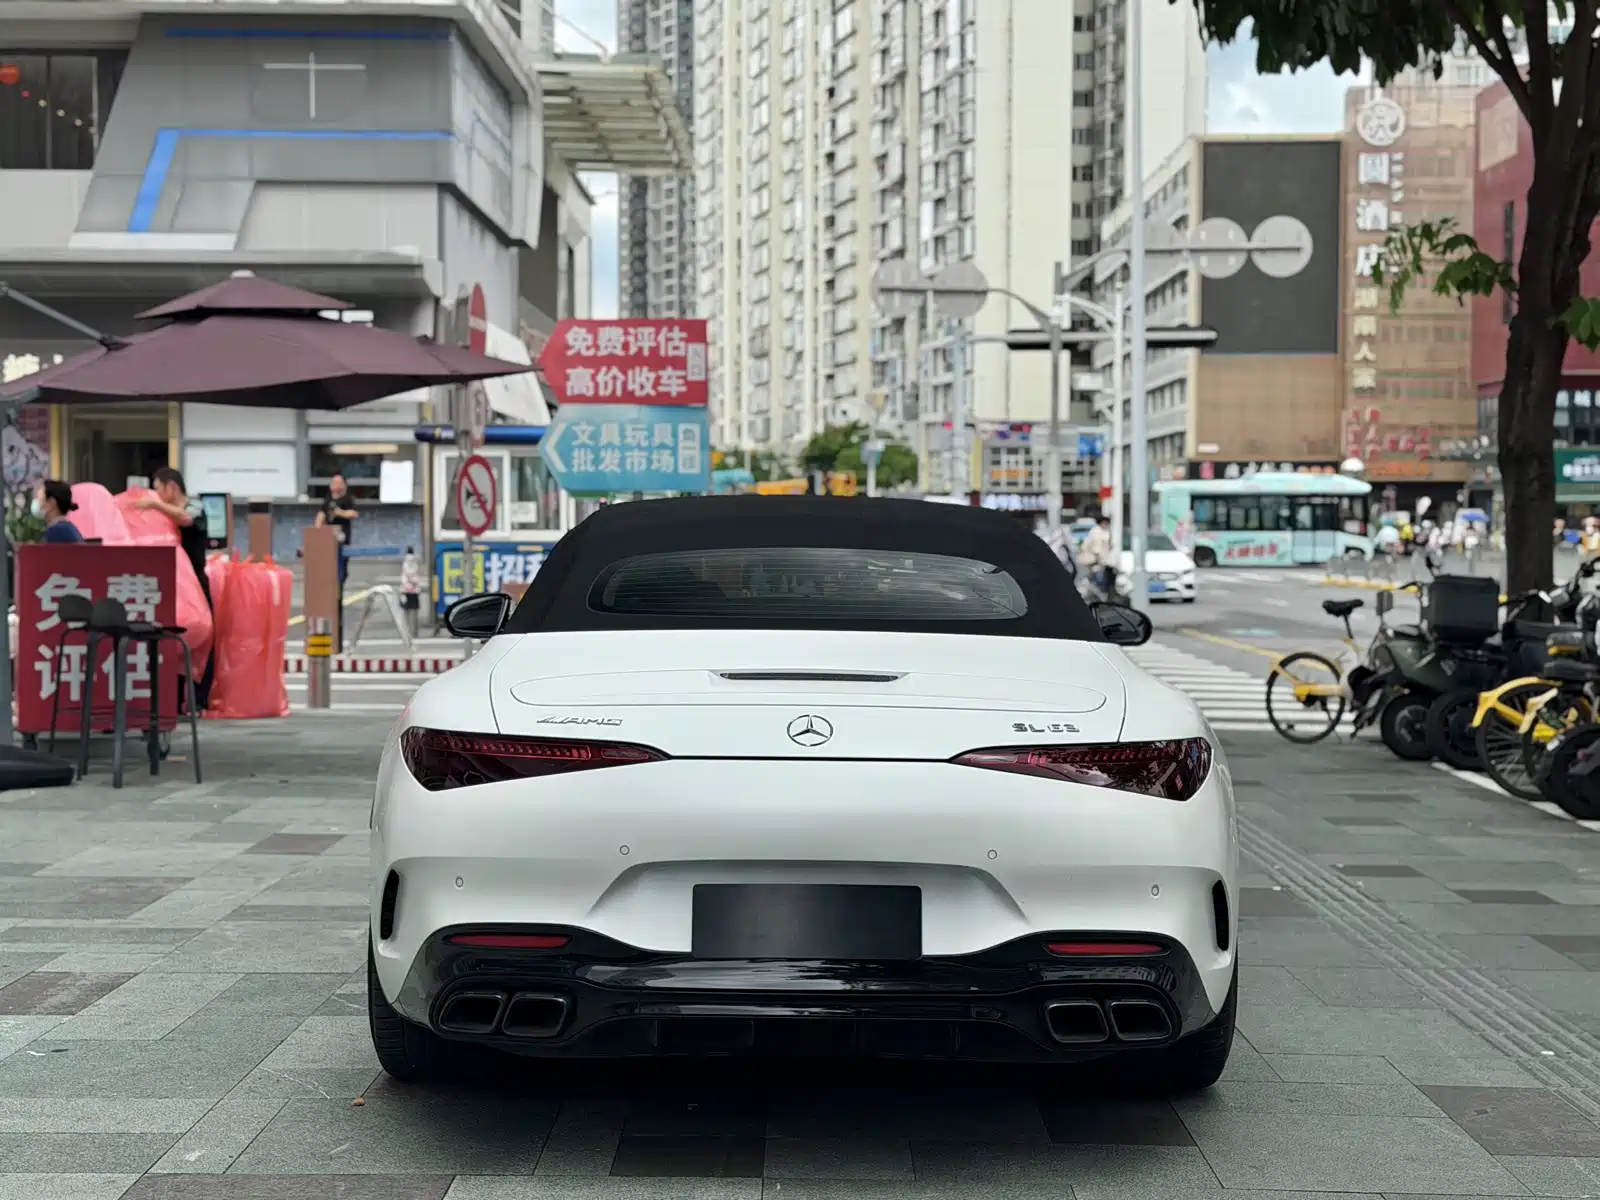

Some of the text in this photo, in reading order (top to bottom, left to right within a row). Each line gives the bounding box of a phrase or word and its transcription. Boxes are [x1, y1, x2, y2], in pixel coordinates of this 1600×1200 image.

[564, 325, 688, 357] 免费评估
[564, 366, 688, 397] 高价收车
[571, 421, 675, 447] 文具玩具
[571, 448, 675, 473] 批发市场
[34, 573, 162, 631] 免费
[34, 641, 164, 701] 评估
[556, 716, 623, 727] AMG
[1012, 722, 1081, 733] SL 63
